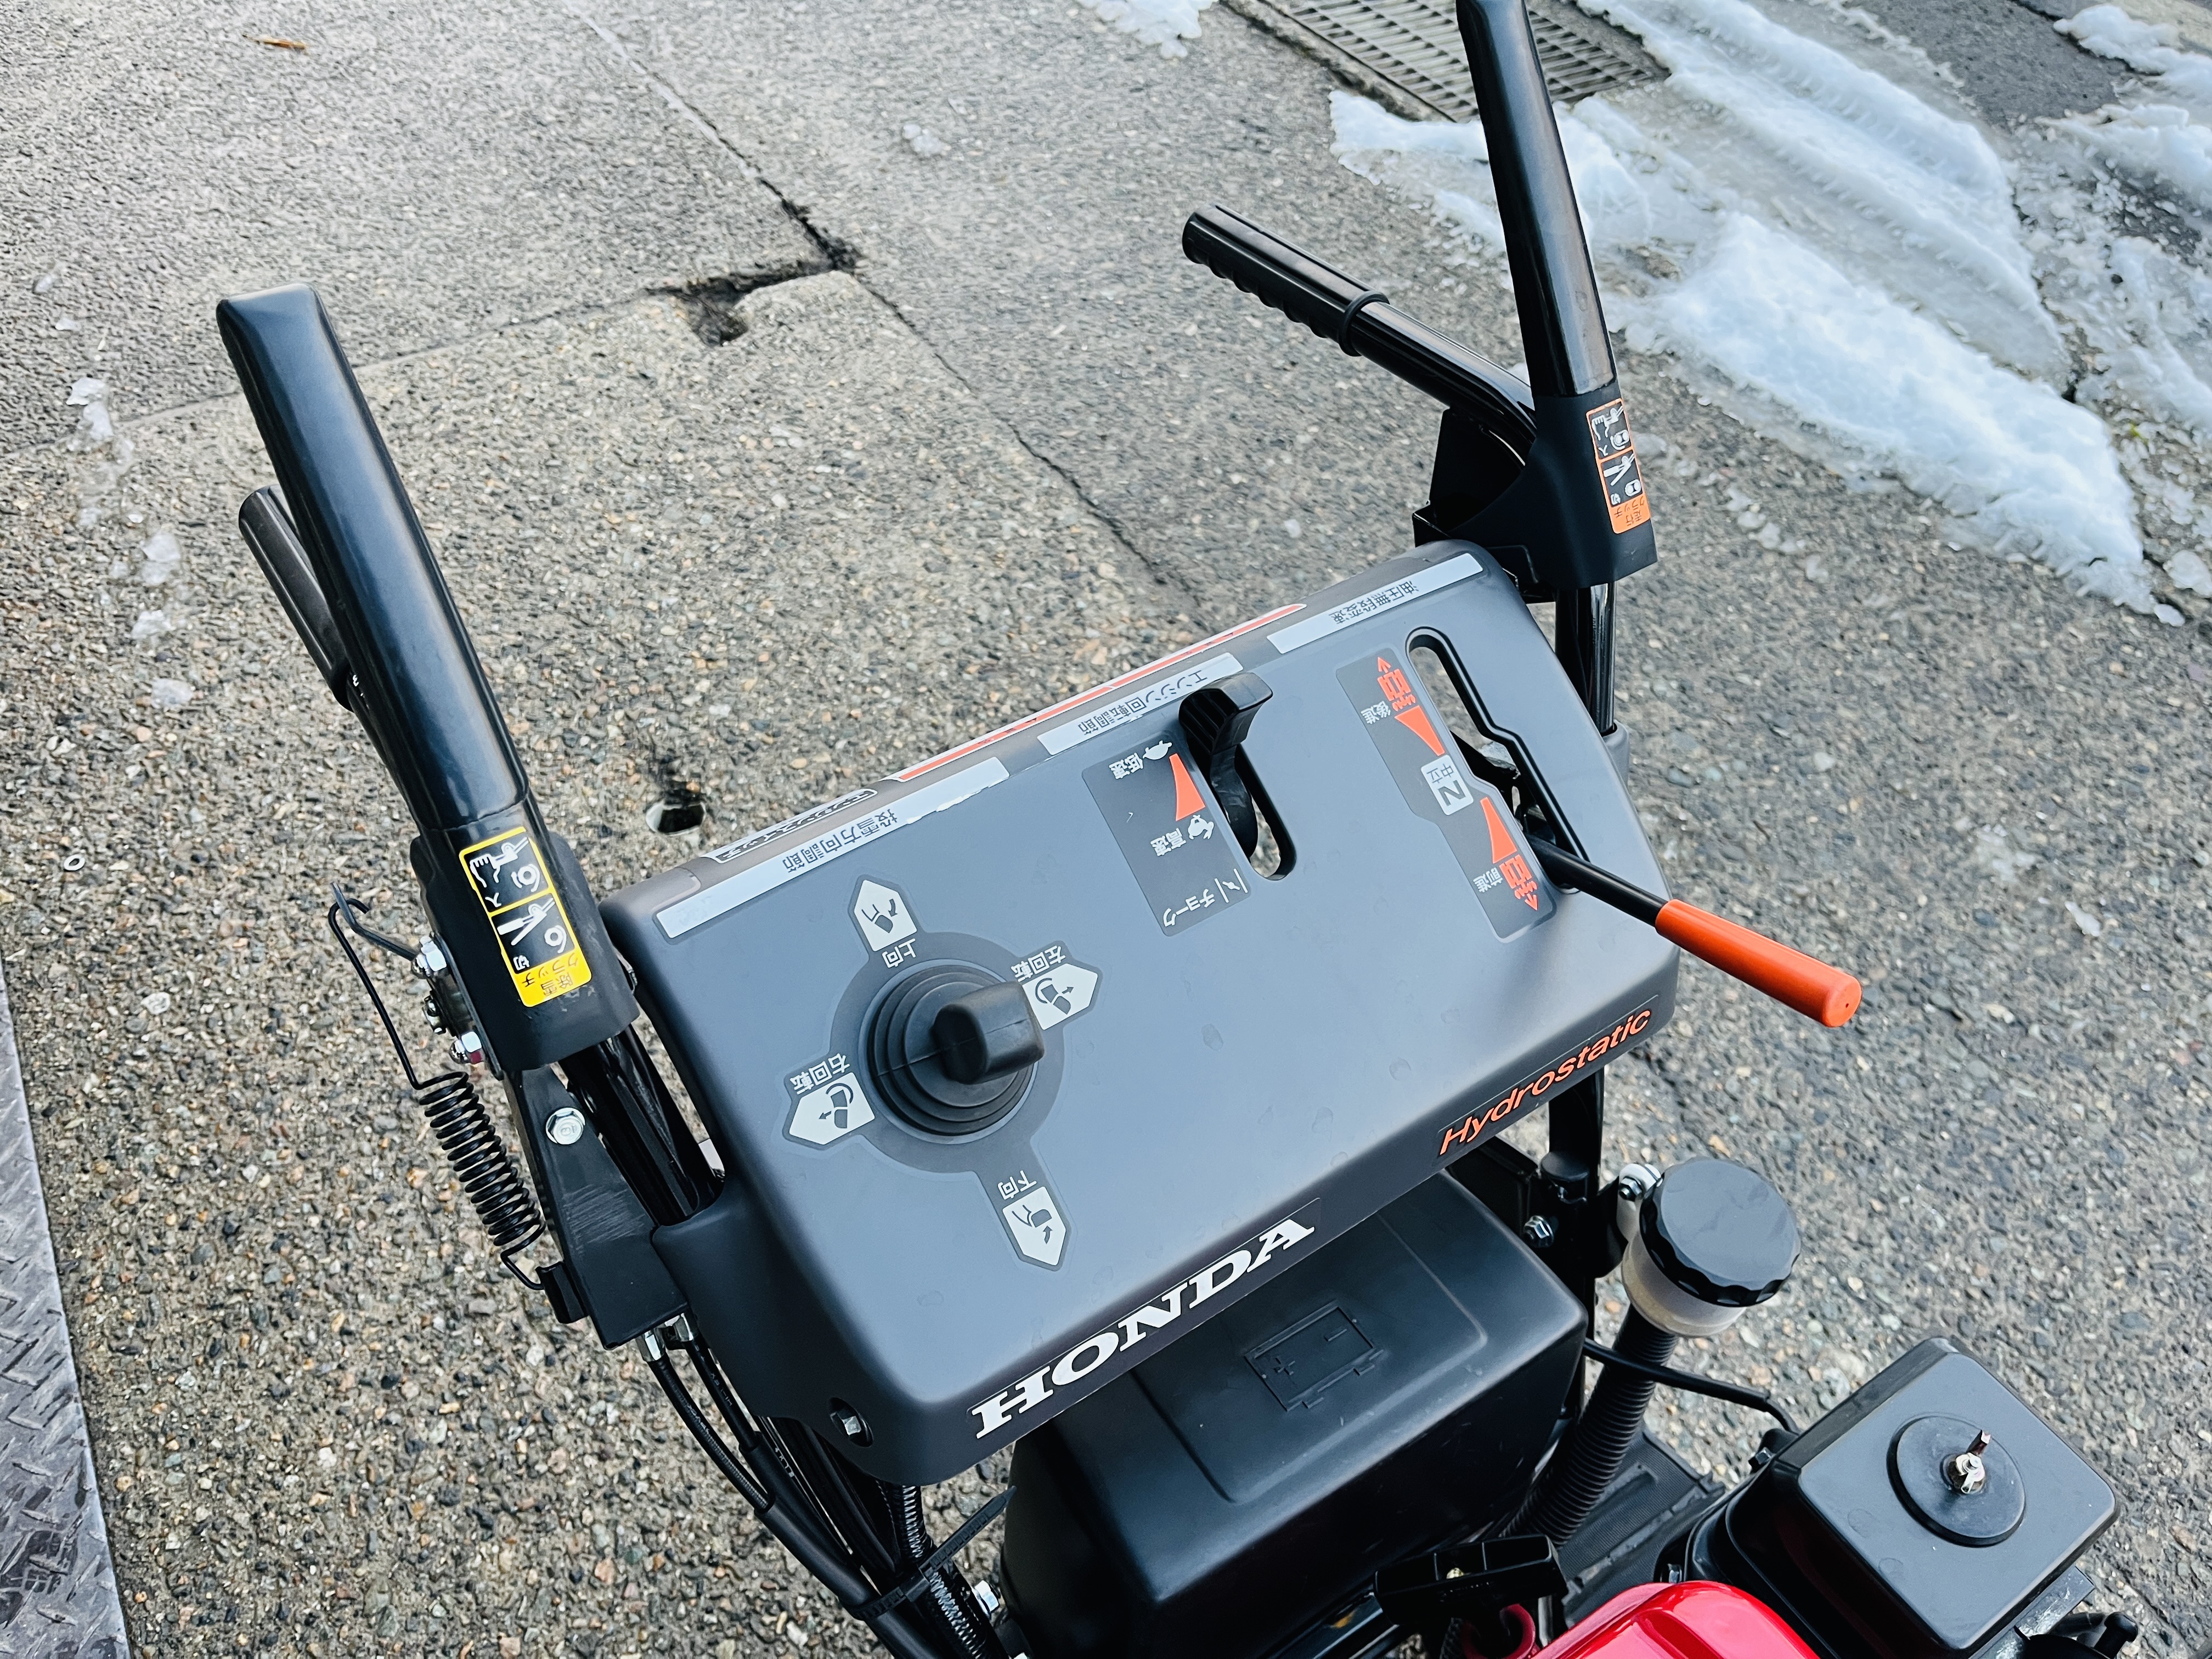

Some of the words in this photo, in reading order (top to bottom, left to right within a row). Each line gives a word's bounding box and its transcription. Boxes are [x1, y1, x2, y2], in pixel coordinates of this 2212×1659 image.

[1614, 496, 1645, 517] クラッチ
[1626, 510, 1642, 526] 走行
[1329, 581, 1419, 624] 油圧無段変速
[1077, 670, 1208, 735] エンジン回転調節
[1361, 701, 1391, 724] 後進
[1109, 752, 1144, 780] 低速
[1426, 764, 1454, 783] 中立
[1437, 780, 1466, 806] N
[723, 792, 870, 859] エンジンスイッチ
[782, 809, 898, 873] 投雪方向調節
[1150, 828, 1187, 856] 高速
[1473, 867, 1503, 893] 前進
[485, 893, 501, 907] 入
[1163, 889, 1215, 927] チョーク
[513, 955, 530, 971] 切
[882, 938, 916, 968] 上向
[1011, 945, 1066, 982] 左回転
[522, 953, 578, 987] クラッチ
[540, 972, 573, 997] 除雪
[790, 1053, 850, 1095] 右回転
[1440, 1010, 1650, 1155] Hydrostatic
[997, 1170, 1037, 1200] 下向
[972, 1218, 1315, 1439] HONDA
